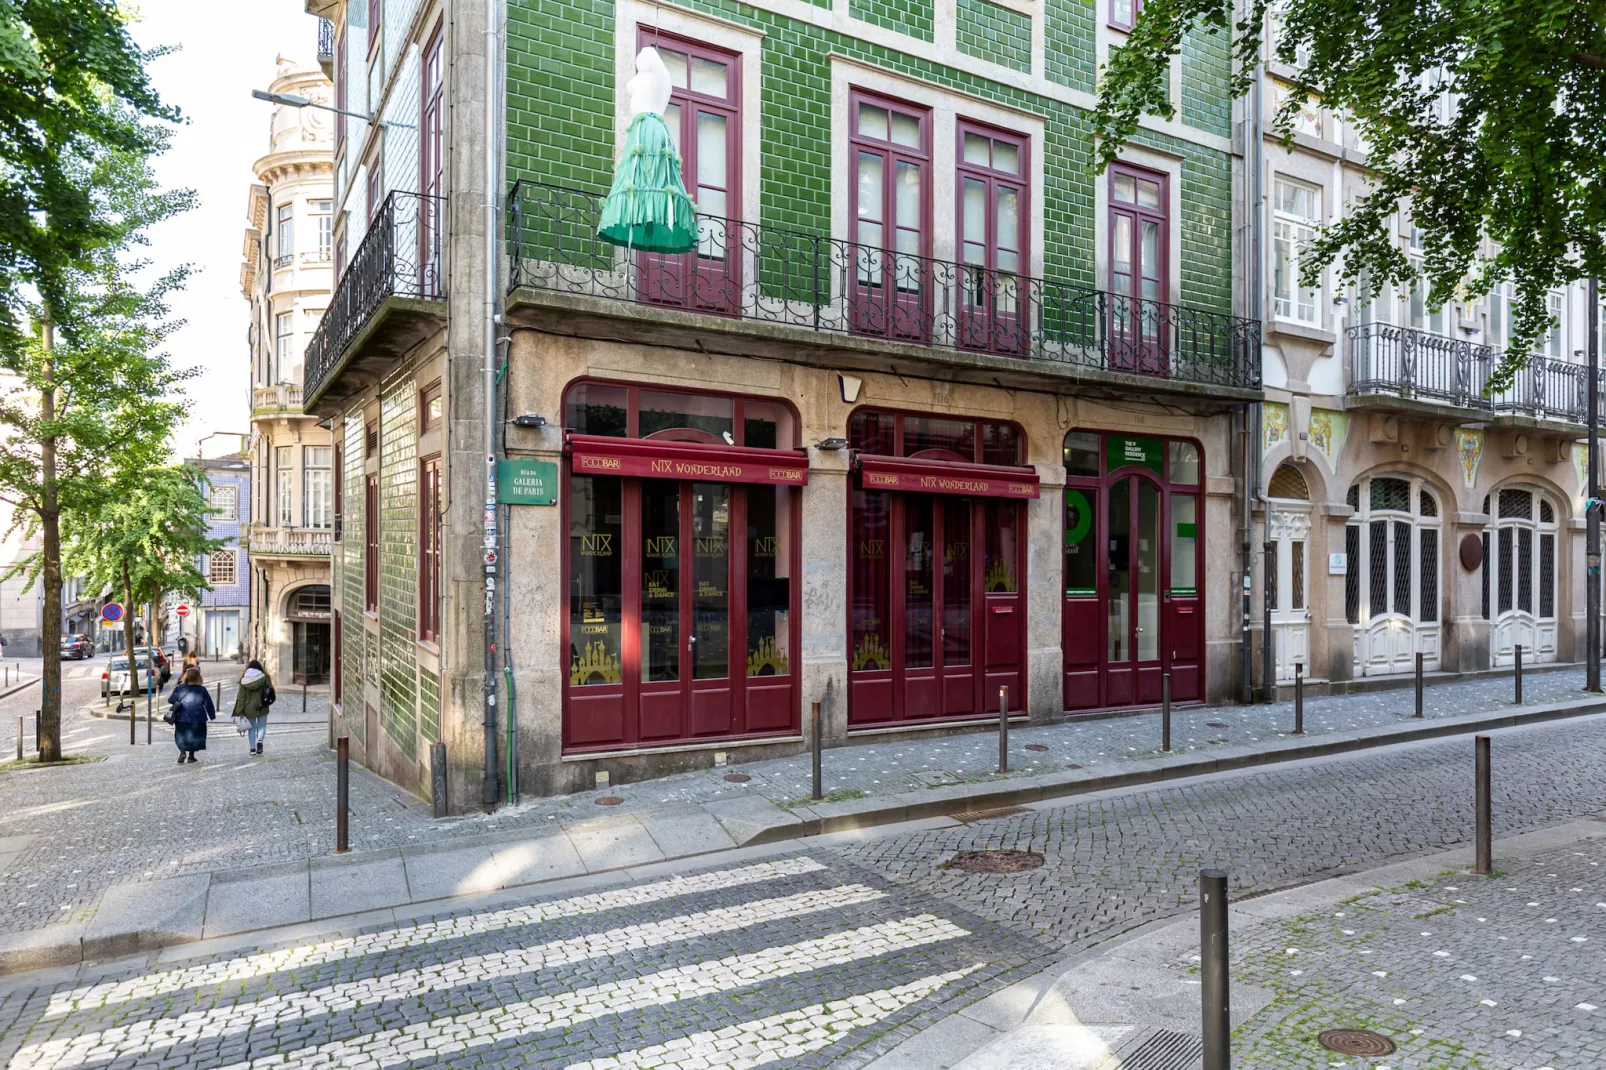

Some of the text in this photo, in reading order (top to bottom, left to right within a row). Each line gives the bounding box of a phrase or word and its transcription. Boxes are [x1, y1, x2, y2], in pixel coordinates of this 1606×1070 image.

[651, 460, 742, 477] NIX WONDERLAND
[514, 478, 542, 486] GALERIA
[920, 476, 988, 492] NIX WONDERLAND
[582, 534, 612, 551] NIX
[648, 536, 675, 553] NIX
[696, 536, 723, 552] NIX
[756, 536, 780, 552] NIX
[860, 540, 884, 554] NIX
